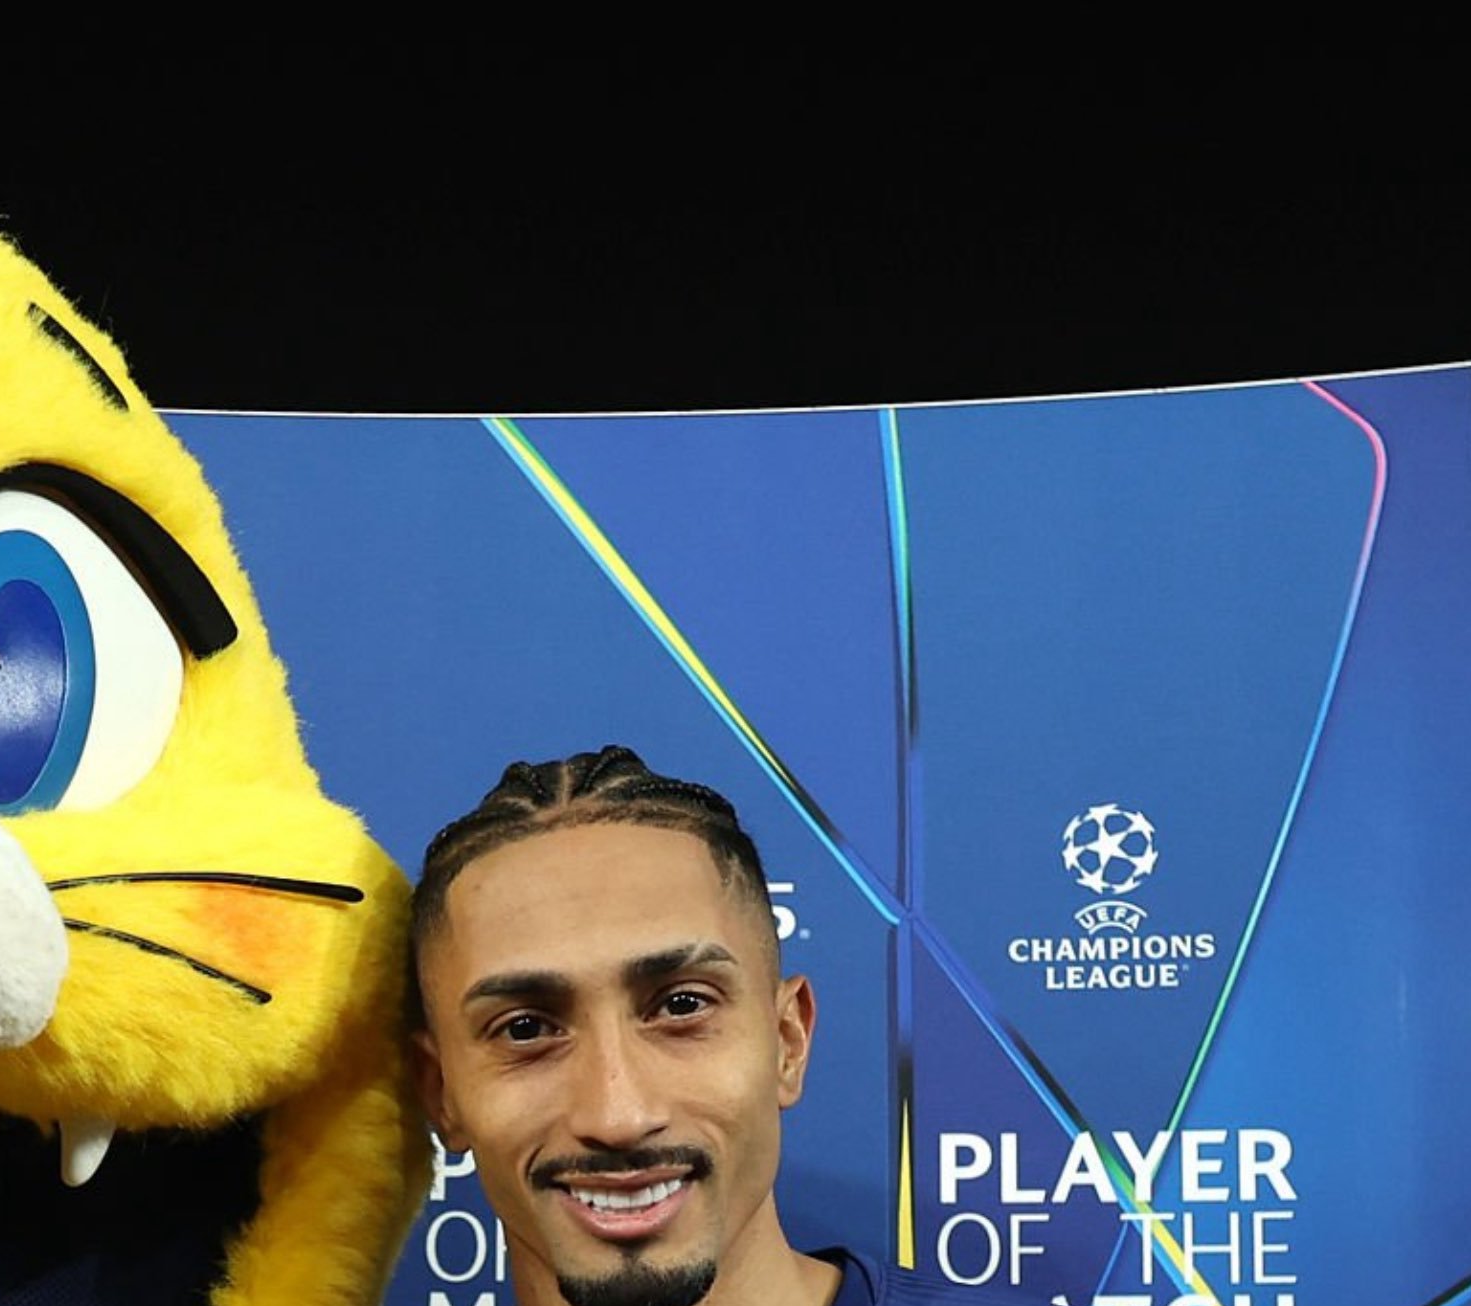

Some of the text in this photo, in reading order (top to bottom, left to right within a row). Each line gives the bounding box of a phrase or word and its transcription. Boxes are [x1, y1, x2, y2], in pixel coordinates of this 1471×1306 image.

[1077, 906, 1141, 931] UEFA
[1008, 933, 1215, 962] CHAMPIONS
[939, 1129, 1297, 1204] PLAYER
[937, 1211, 1297, 1285] OF THE
